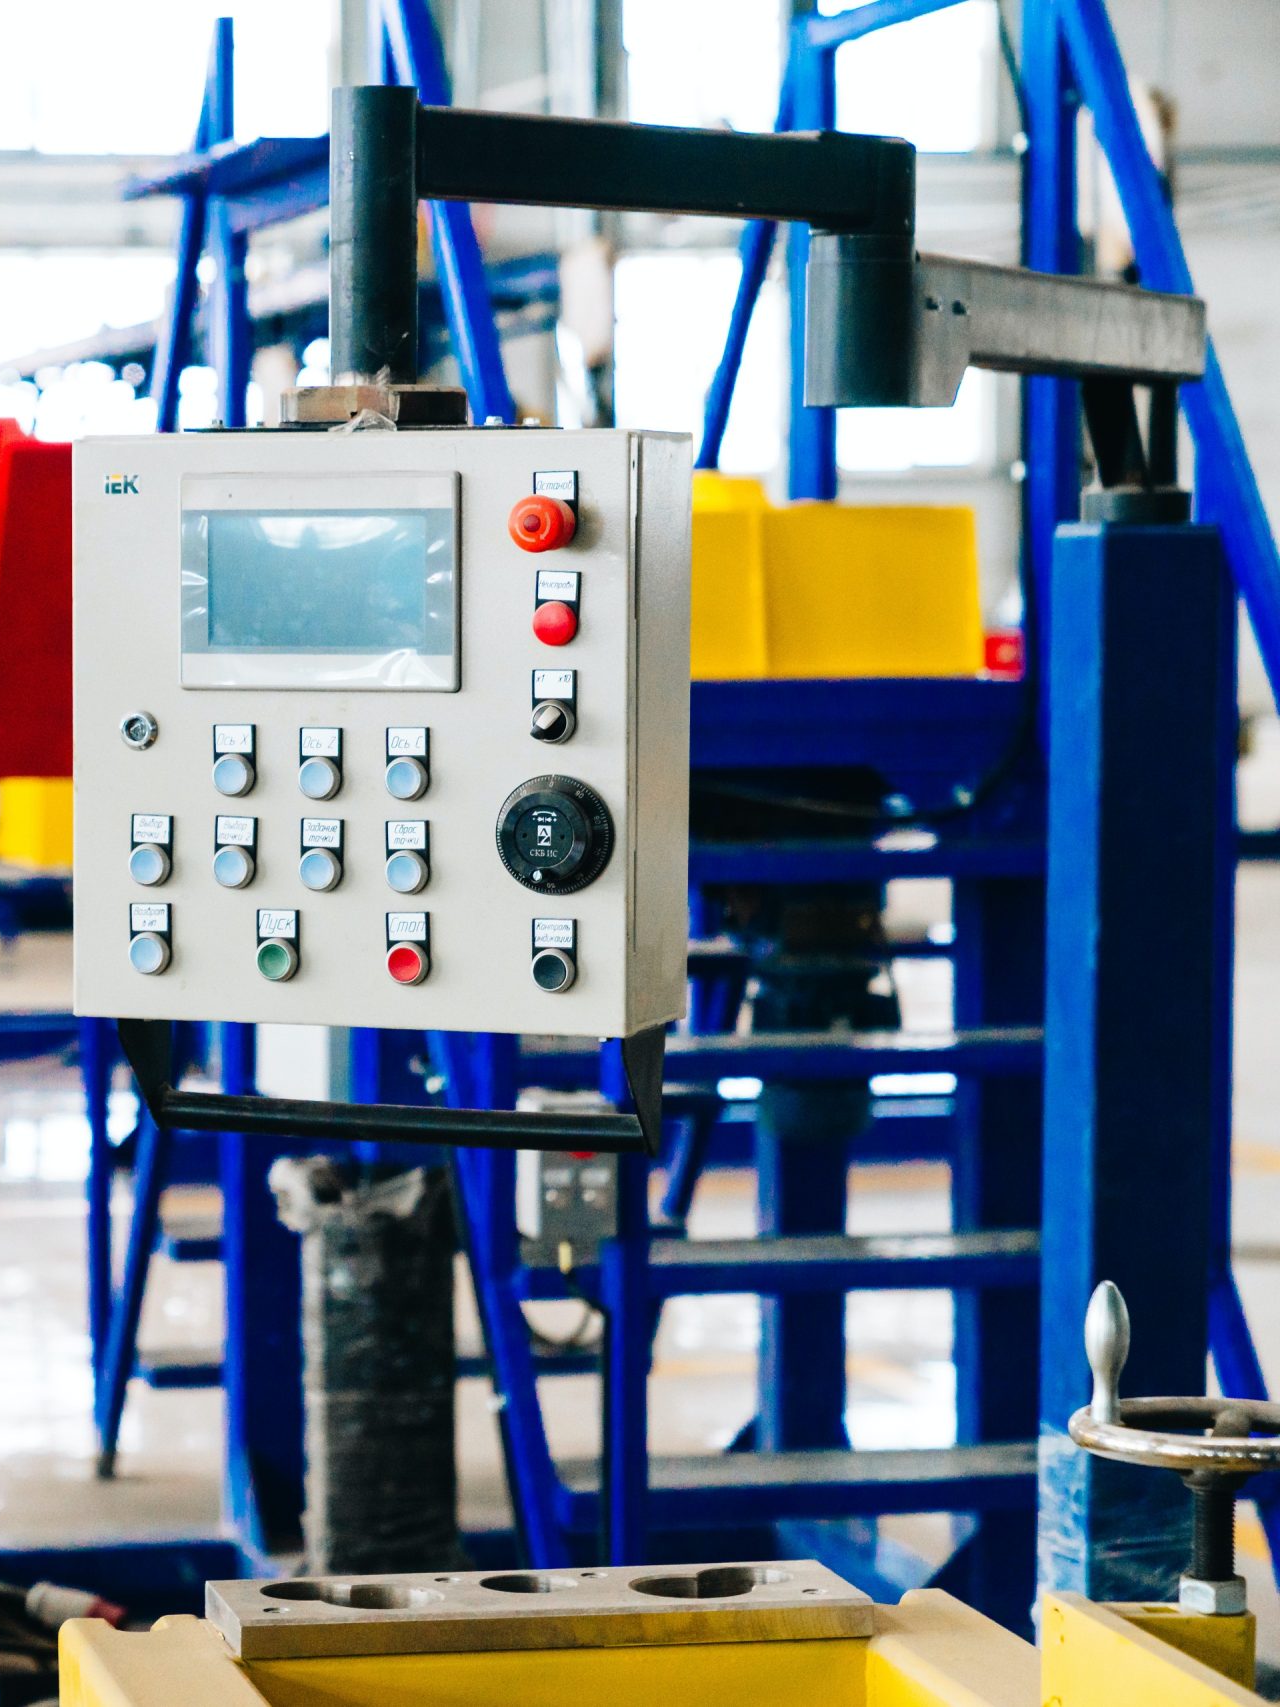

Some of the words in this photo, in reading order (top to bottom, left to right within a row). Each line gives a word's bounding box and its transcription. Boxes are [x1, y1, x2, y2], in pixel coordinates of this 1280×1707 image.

[217, 733, 236, 746] Ось
[303, 735, 322, 748] Ось
[390, 735, 410, 748] Ось
[530, 849, 546, 857] СКБ
[260, 913, 294, 935] Пуск
[390, 917, 425, 933] Стоп
